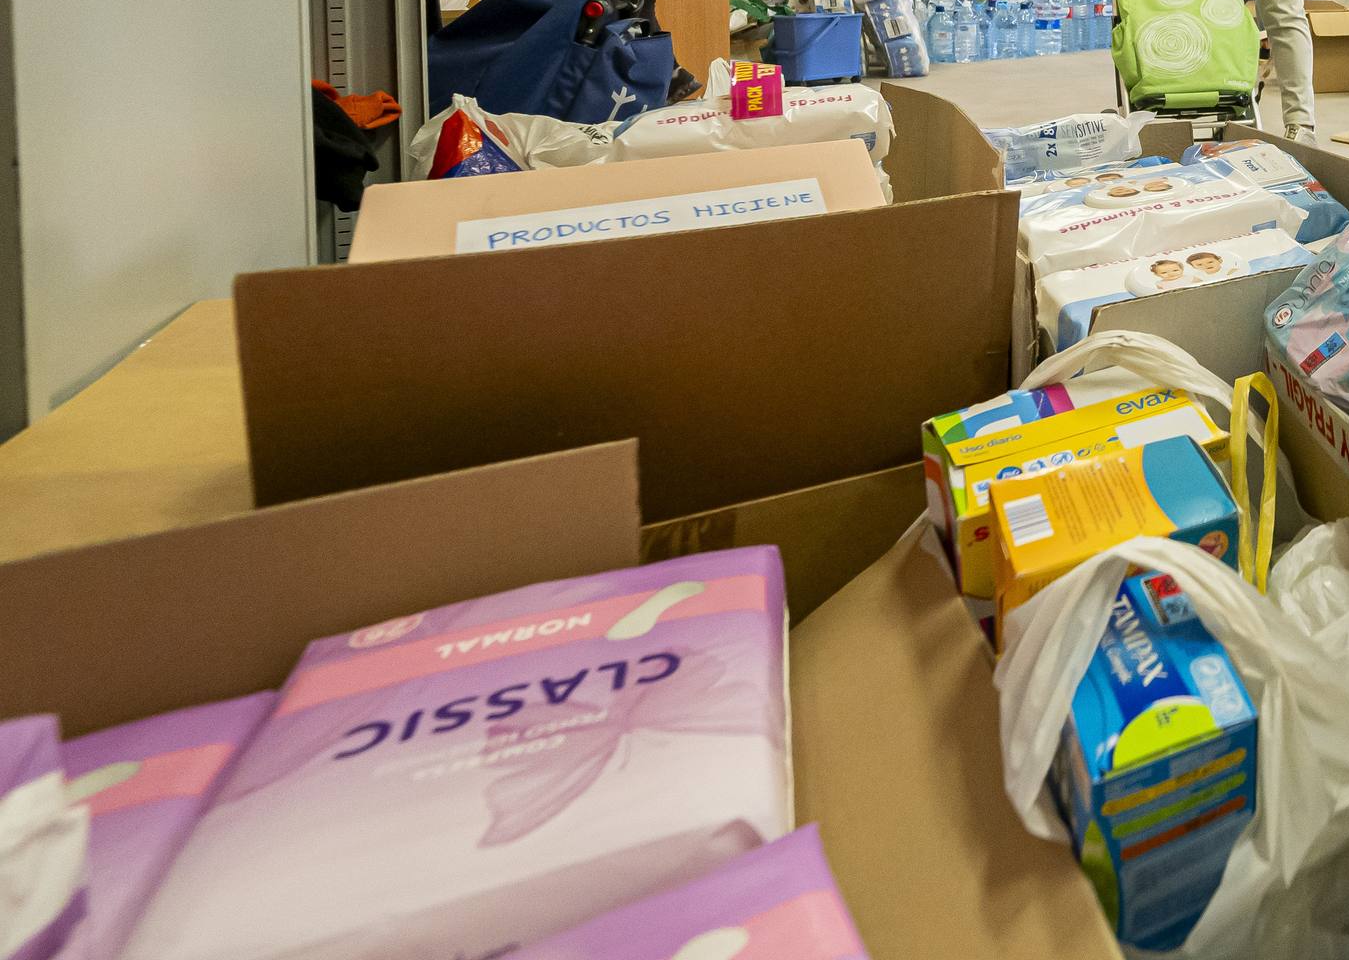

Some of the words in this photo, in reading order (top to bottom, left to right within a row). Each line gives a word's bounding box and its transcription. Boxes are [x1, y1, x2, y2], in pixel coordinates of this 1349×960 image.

[747, 82, 764, 112] PACK
[788, 94, 854, 107] Frescas
[487, 209, 672, 250] PRODUCTOS
[692, 192, 815, 218] HIGIENE
[1115, 388, 1178, 416] evax
[959, 442, 985, 456] Uso
[436, 611, 594, 661] NORMAL
[1111, 593, 1169, 688] TAMPAX
[333, 651, 685, 761] CLASSIC
